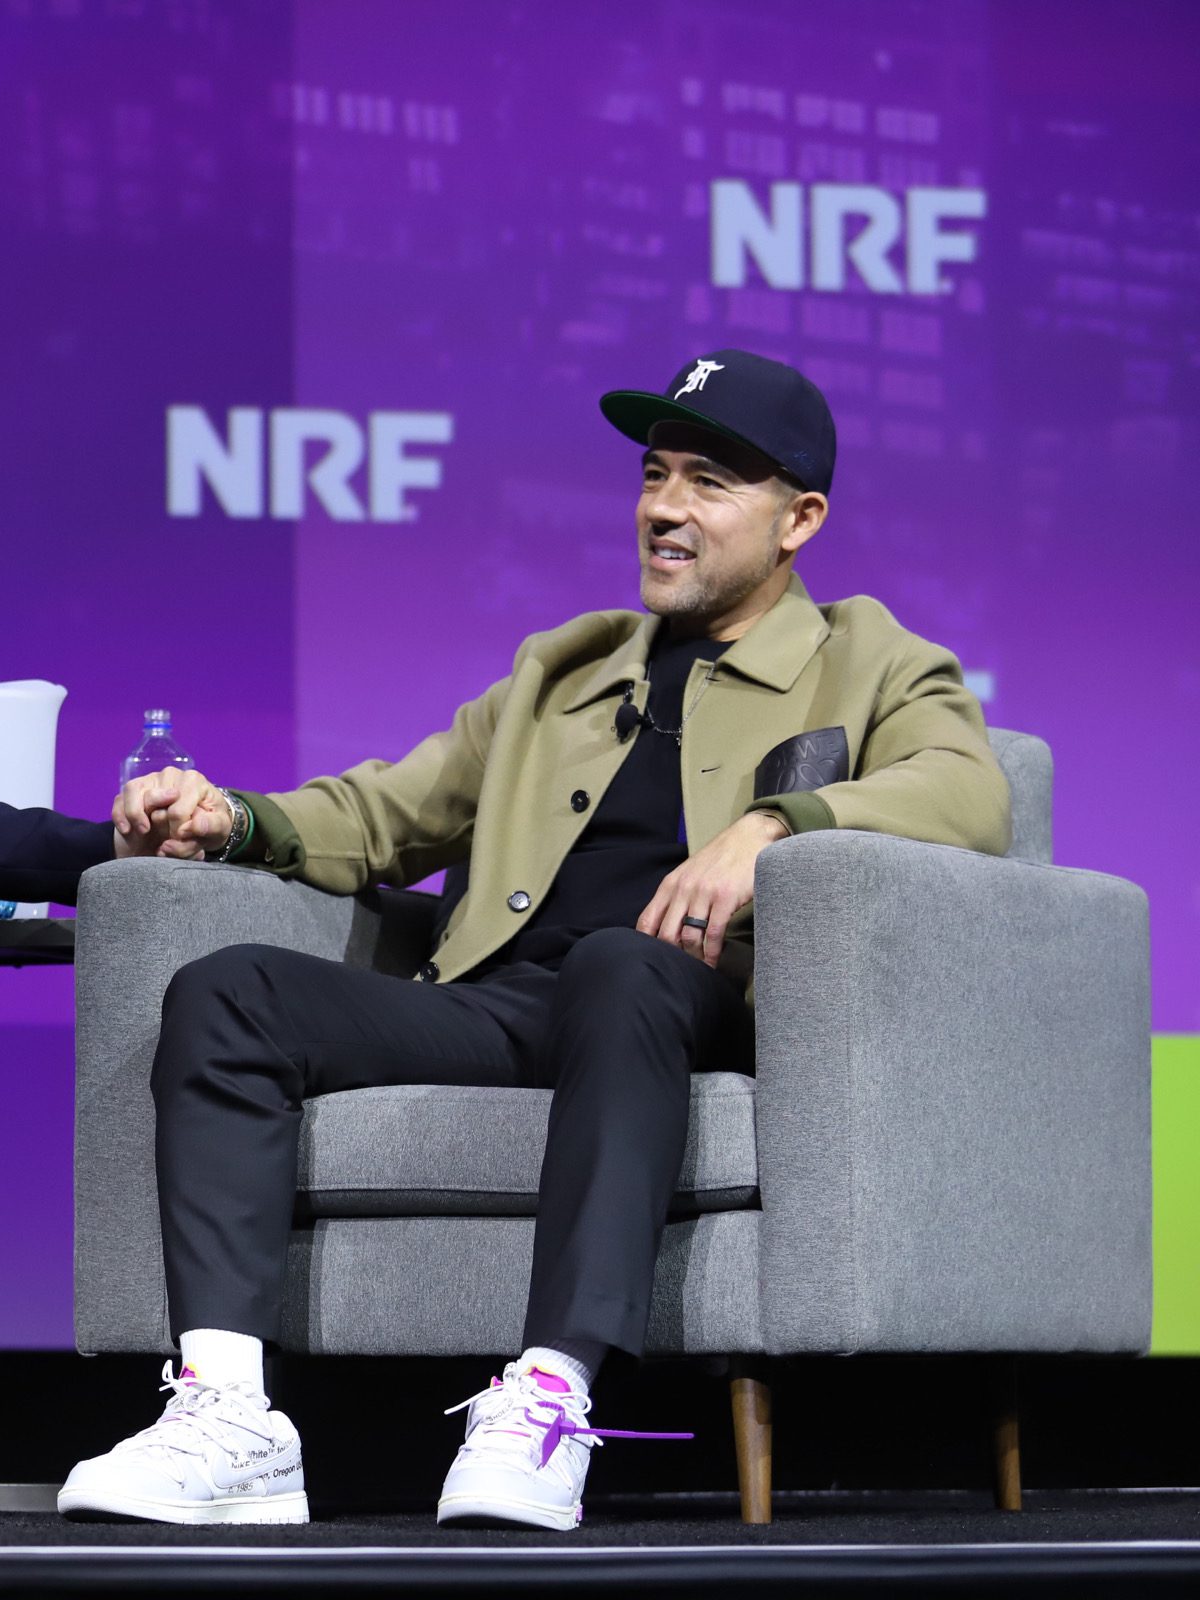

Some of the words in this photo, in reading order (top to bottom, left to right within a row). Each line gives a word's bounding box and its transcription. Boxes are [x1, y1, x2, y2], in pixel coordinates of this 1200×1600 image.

[711, 180, 986, 294] NRF
[168, 406, 453, 522] NRF
[273, 1464, 295, 1478] Oregon
